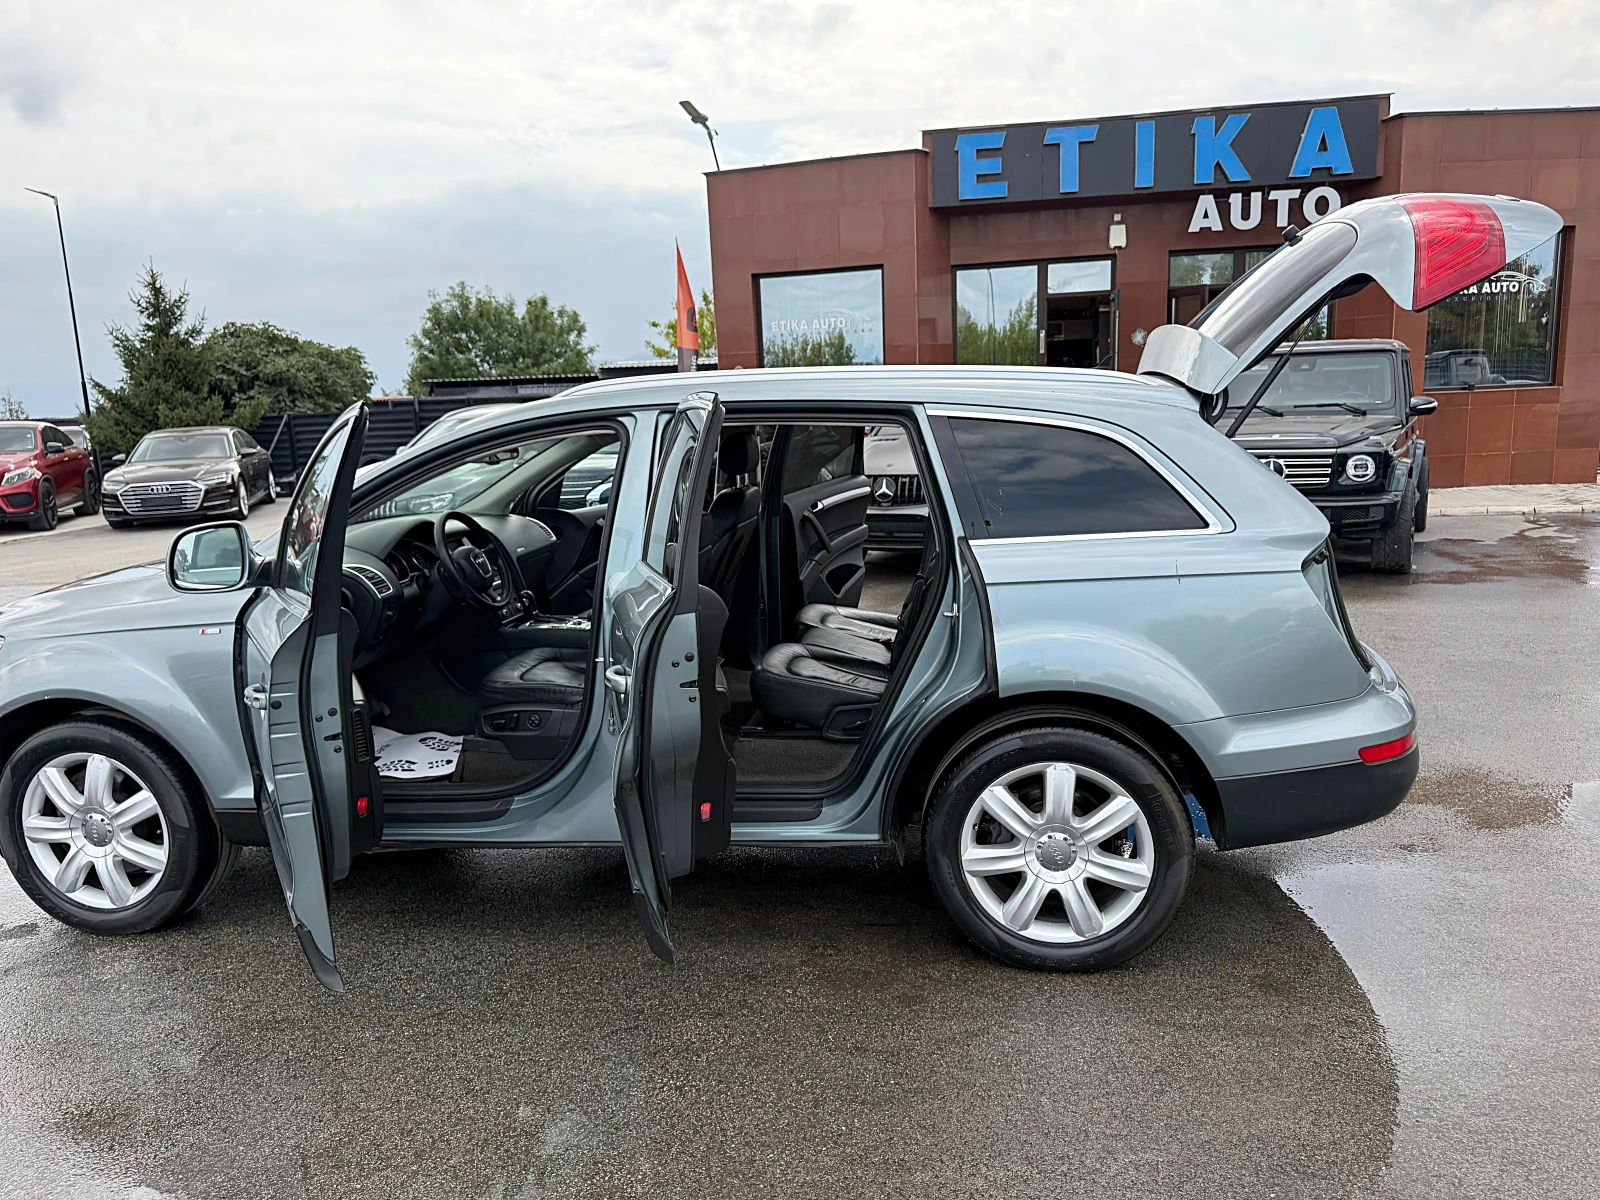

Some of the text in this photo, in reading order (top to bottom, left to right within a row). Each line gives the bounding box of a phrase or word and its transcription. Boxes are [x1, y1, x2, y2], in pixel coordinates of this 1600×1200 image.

[954, 106, 1354, 200] ETIKA
[1187, 186, 1342, 233] AUTO
[1481, 281, 1519, 294] AUTO
[771, 317, 846, 332] ETIKA AUTO
